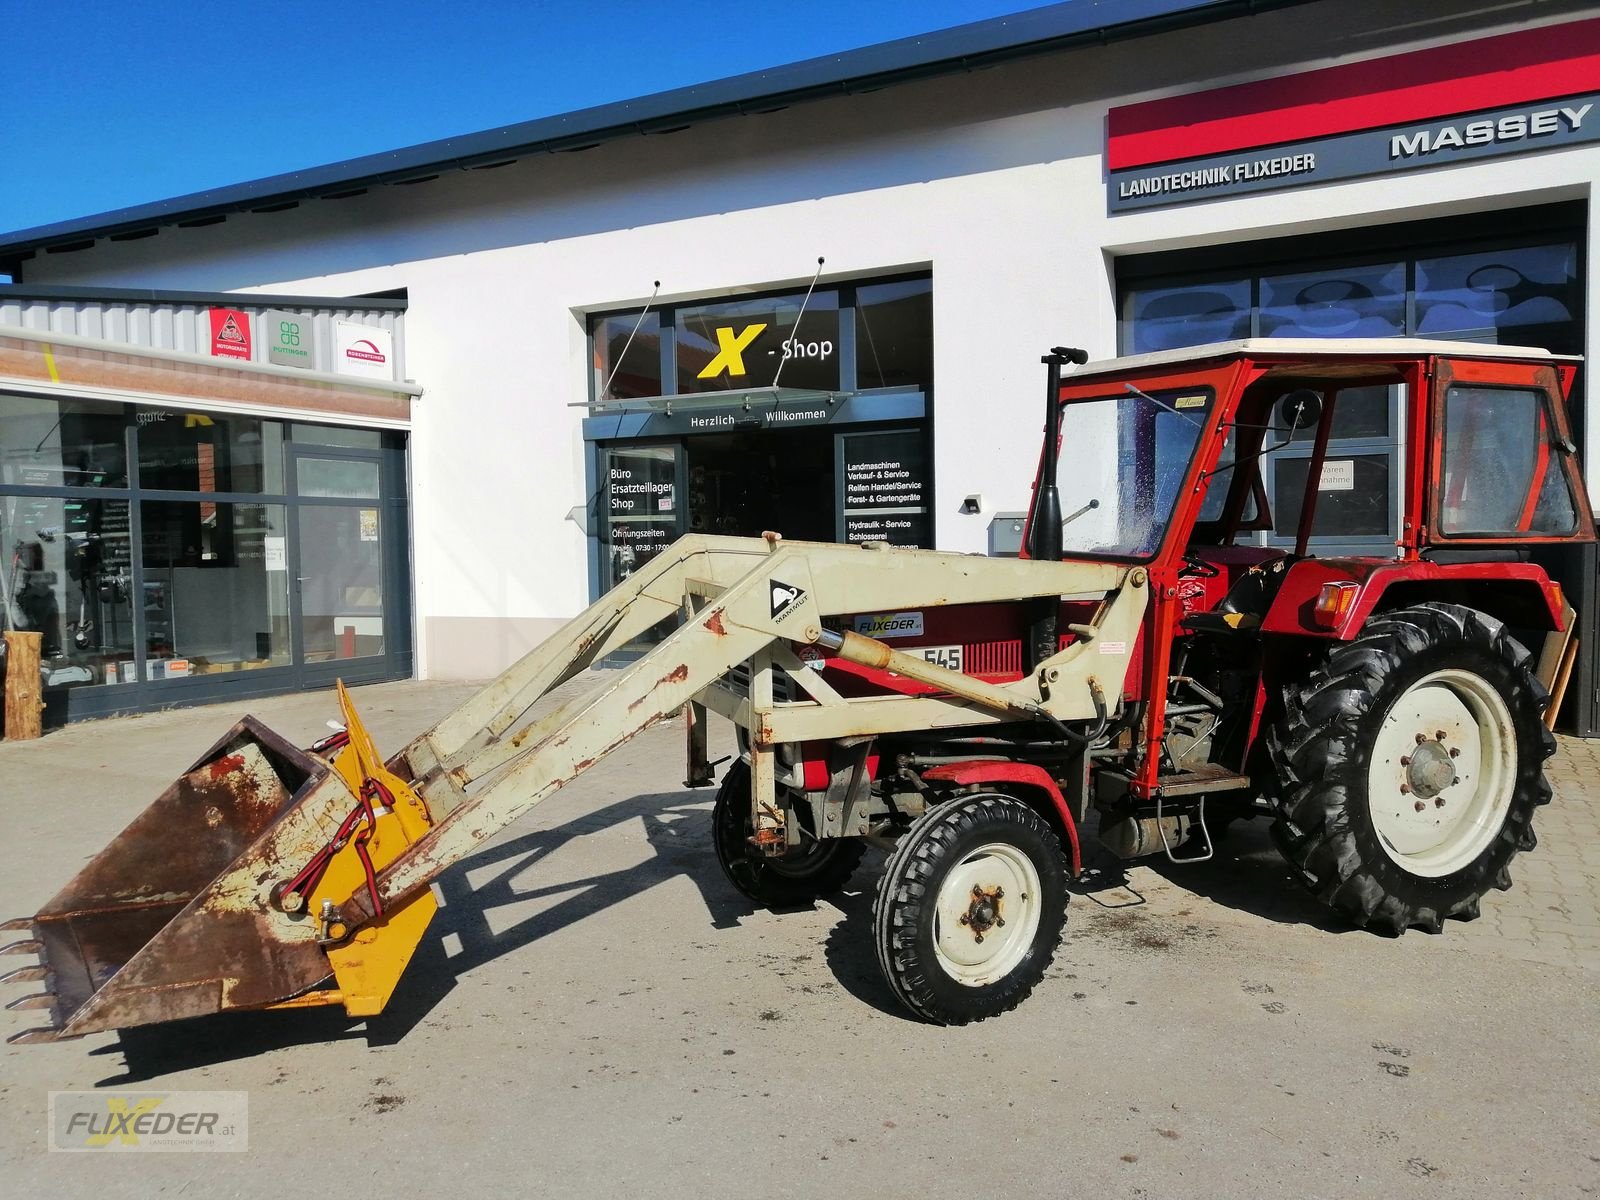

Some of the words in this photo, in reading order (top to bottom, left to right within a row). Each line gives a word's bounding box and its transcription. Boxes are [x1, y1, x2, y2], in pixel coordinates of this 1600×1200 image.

[1391, 103, 1594, 157] MASSEY
[1120, 165, 1230, 197] LANDTECHNIK
[1234, 152, 1316, 181] FLIXEDER
[697, 323, 768, 379] X
[781, 338, 833, 361] Shop
[691, 415, 736, 428] Herzlich
[765, 409, 826, 422] Willkommen
[847, 462, 900, 471] Landmaschinen
[610, 468, 632, 479] Büro
[847, 472, 876, 480] Verkauf-
[877, 471, 883, 479] &
[884, 470, 910, 479] Service
[611, 482, 673, 494] Ersatzteillager
[848, 483, 870, 492] Reifen
[870, 481, 922, 492] Handel/Service
[611, 498, 634, 510] Shop
[848, 495, 868, 503] Forst-
[868, 494, 875, 503] &
[876, 493, 921, 503] Gartengeräte
[848, 521, 880, 530] Hydraulik
[885, 520, 911, 528] Service
[848, 532, 888, 541] Schlosserei
[635, 544, 651, 552] 07:30
[775, 594, 809, 625] MAMMUT
[859, 619, 915, 632] FLIXEDER
[924, 649, 960, 670] 545
